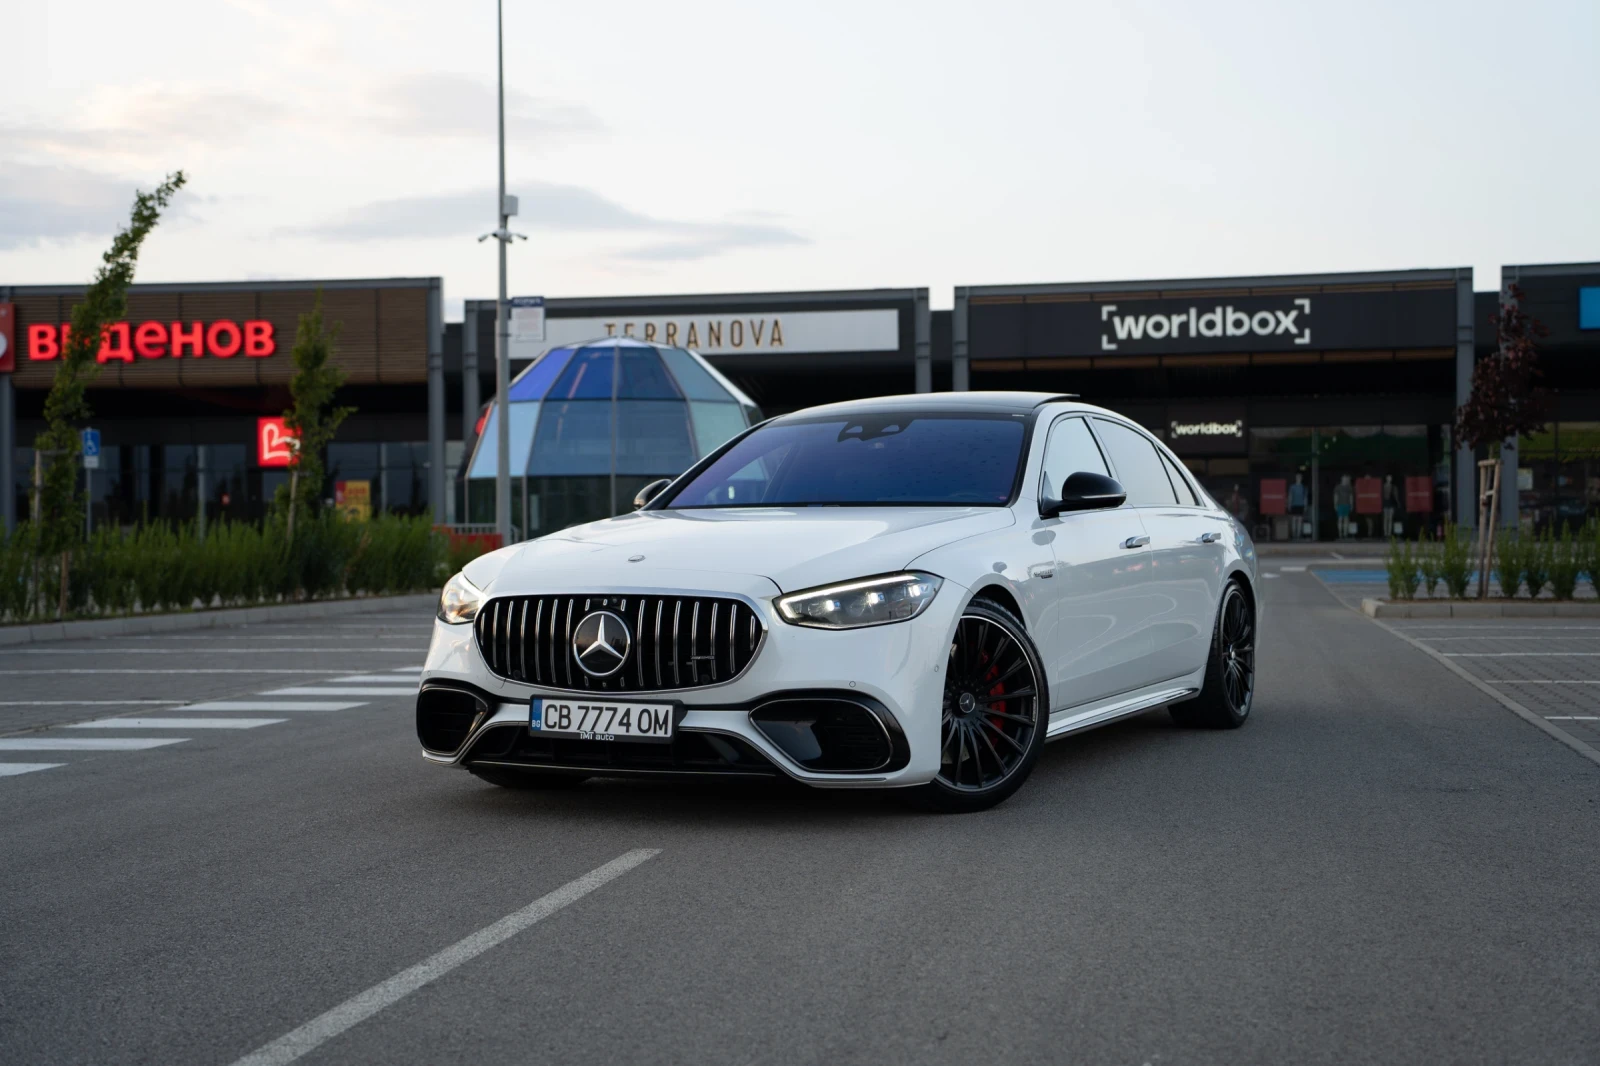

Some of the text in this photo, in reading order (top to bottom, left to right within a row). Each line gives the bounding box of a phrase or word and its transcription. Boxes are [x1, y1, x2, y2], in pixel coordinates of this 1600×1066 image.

[531, 703, 670, 735] BG CB 7774 OM
[595, 733, 615, 741] auto
